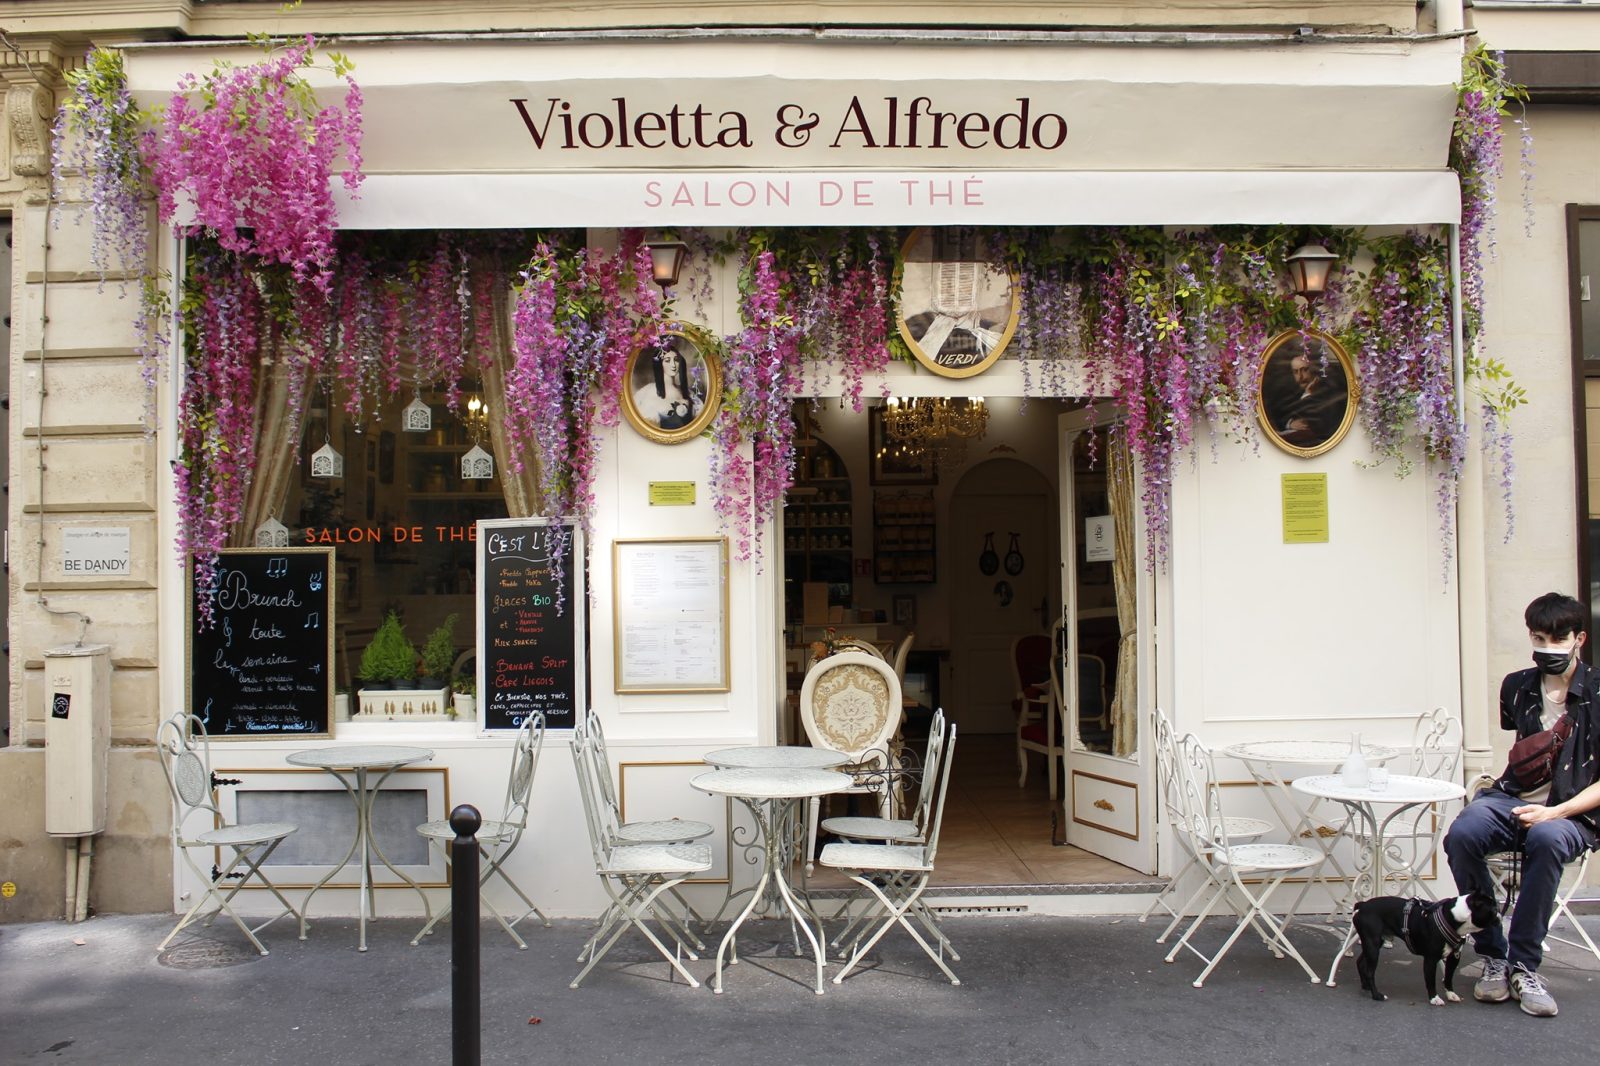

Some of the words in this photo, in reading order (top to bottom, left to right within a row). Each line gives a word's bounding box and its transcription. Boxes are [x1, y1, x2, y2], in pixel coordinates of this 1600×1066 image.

[509, 97, 753, 149] Violetta
[775, 104, 820, 148] &
[829, 96, 1068, 149] Alfredo
[644, 180, 790, 207] SALON
[819, 180, 874, 206] DE
[900, 175, 984, 206] THÉ
[938, 354, 978, 365] VERDI
[305, 527, 381, 543] SALON
[394, 527, 423, 542] DE
[65, 560, 81, 570] BE
[85, 559, 127, 570] DANDY
[218, 570, 303, 611] Brunch
[533, 594, 551, 606] BIO
[249, 618, 286, 640] toute
[240, 652, 297, 668] semaine
